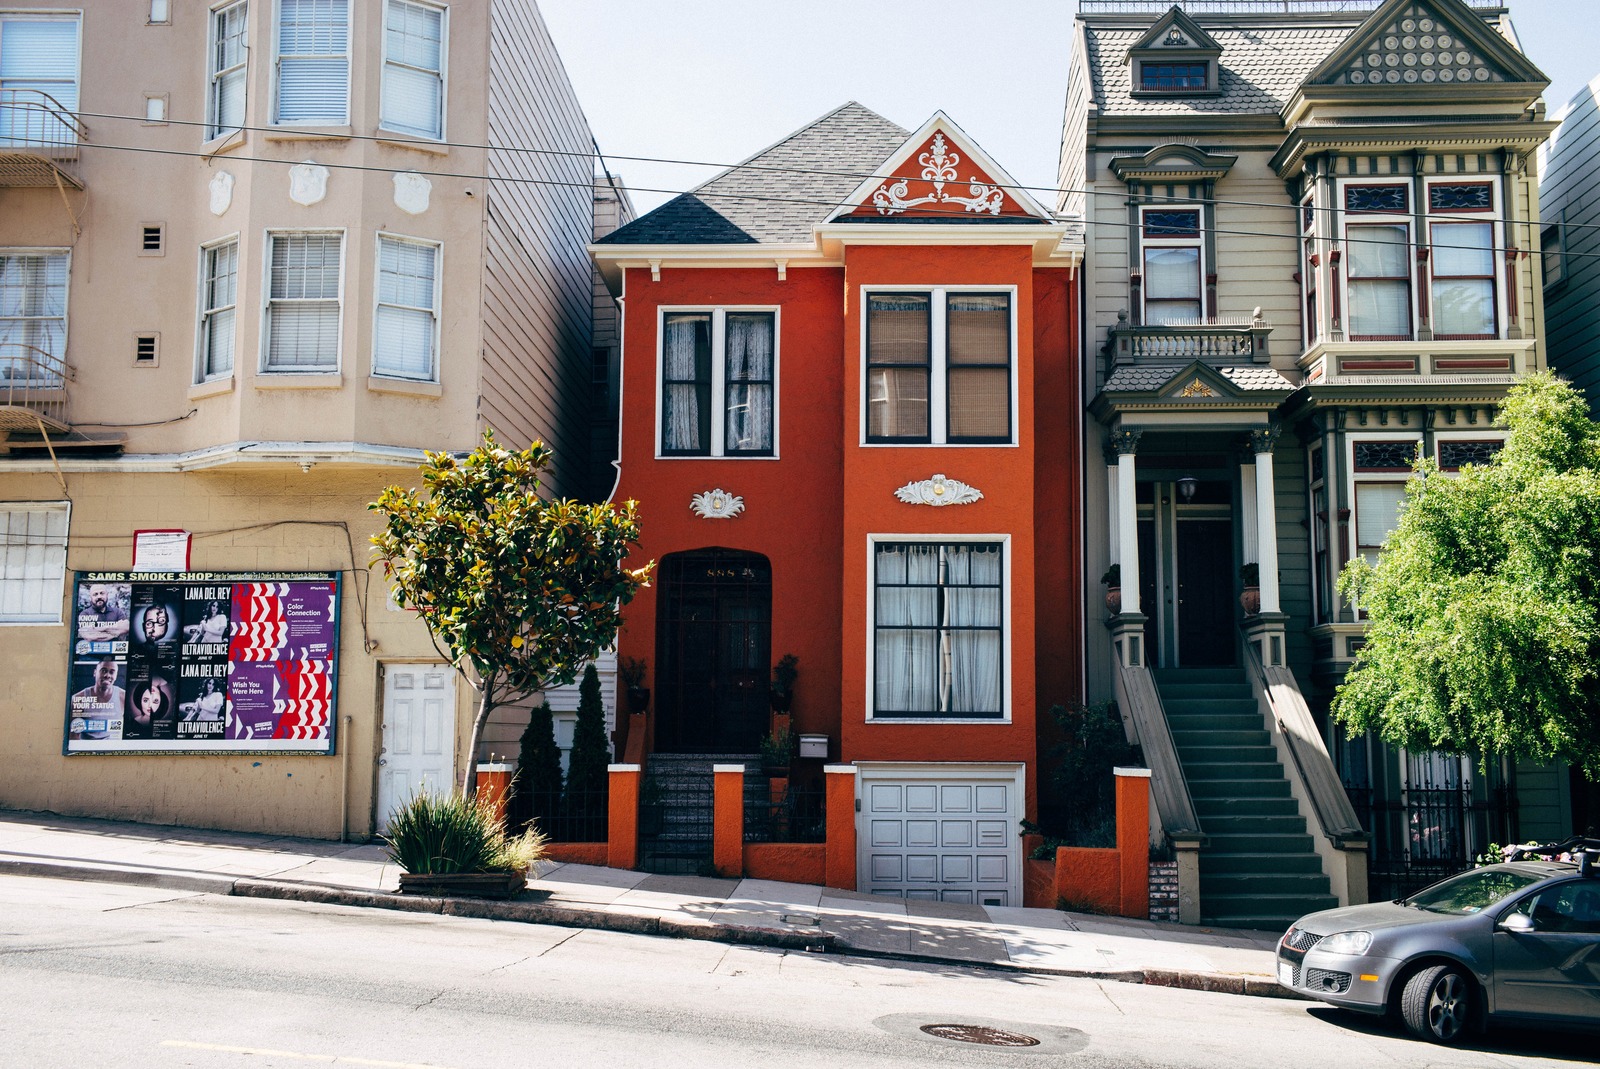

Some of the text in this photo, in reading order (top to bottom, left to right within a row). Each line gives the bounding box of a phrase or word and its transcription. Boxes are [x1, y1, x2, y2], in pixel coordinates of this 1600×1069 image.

[185, 587, 231, 600] LANA DEL REY
[182, 644, 228, 655] ULTRAVIOLENCE
[181, 664, 227, 677] LANA DEL REY
[177, 722, 224, 733] ULTRAVIOLENCE
